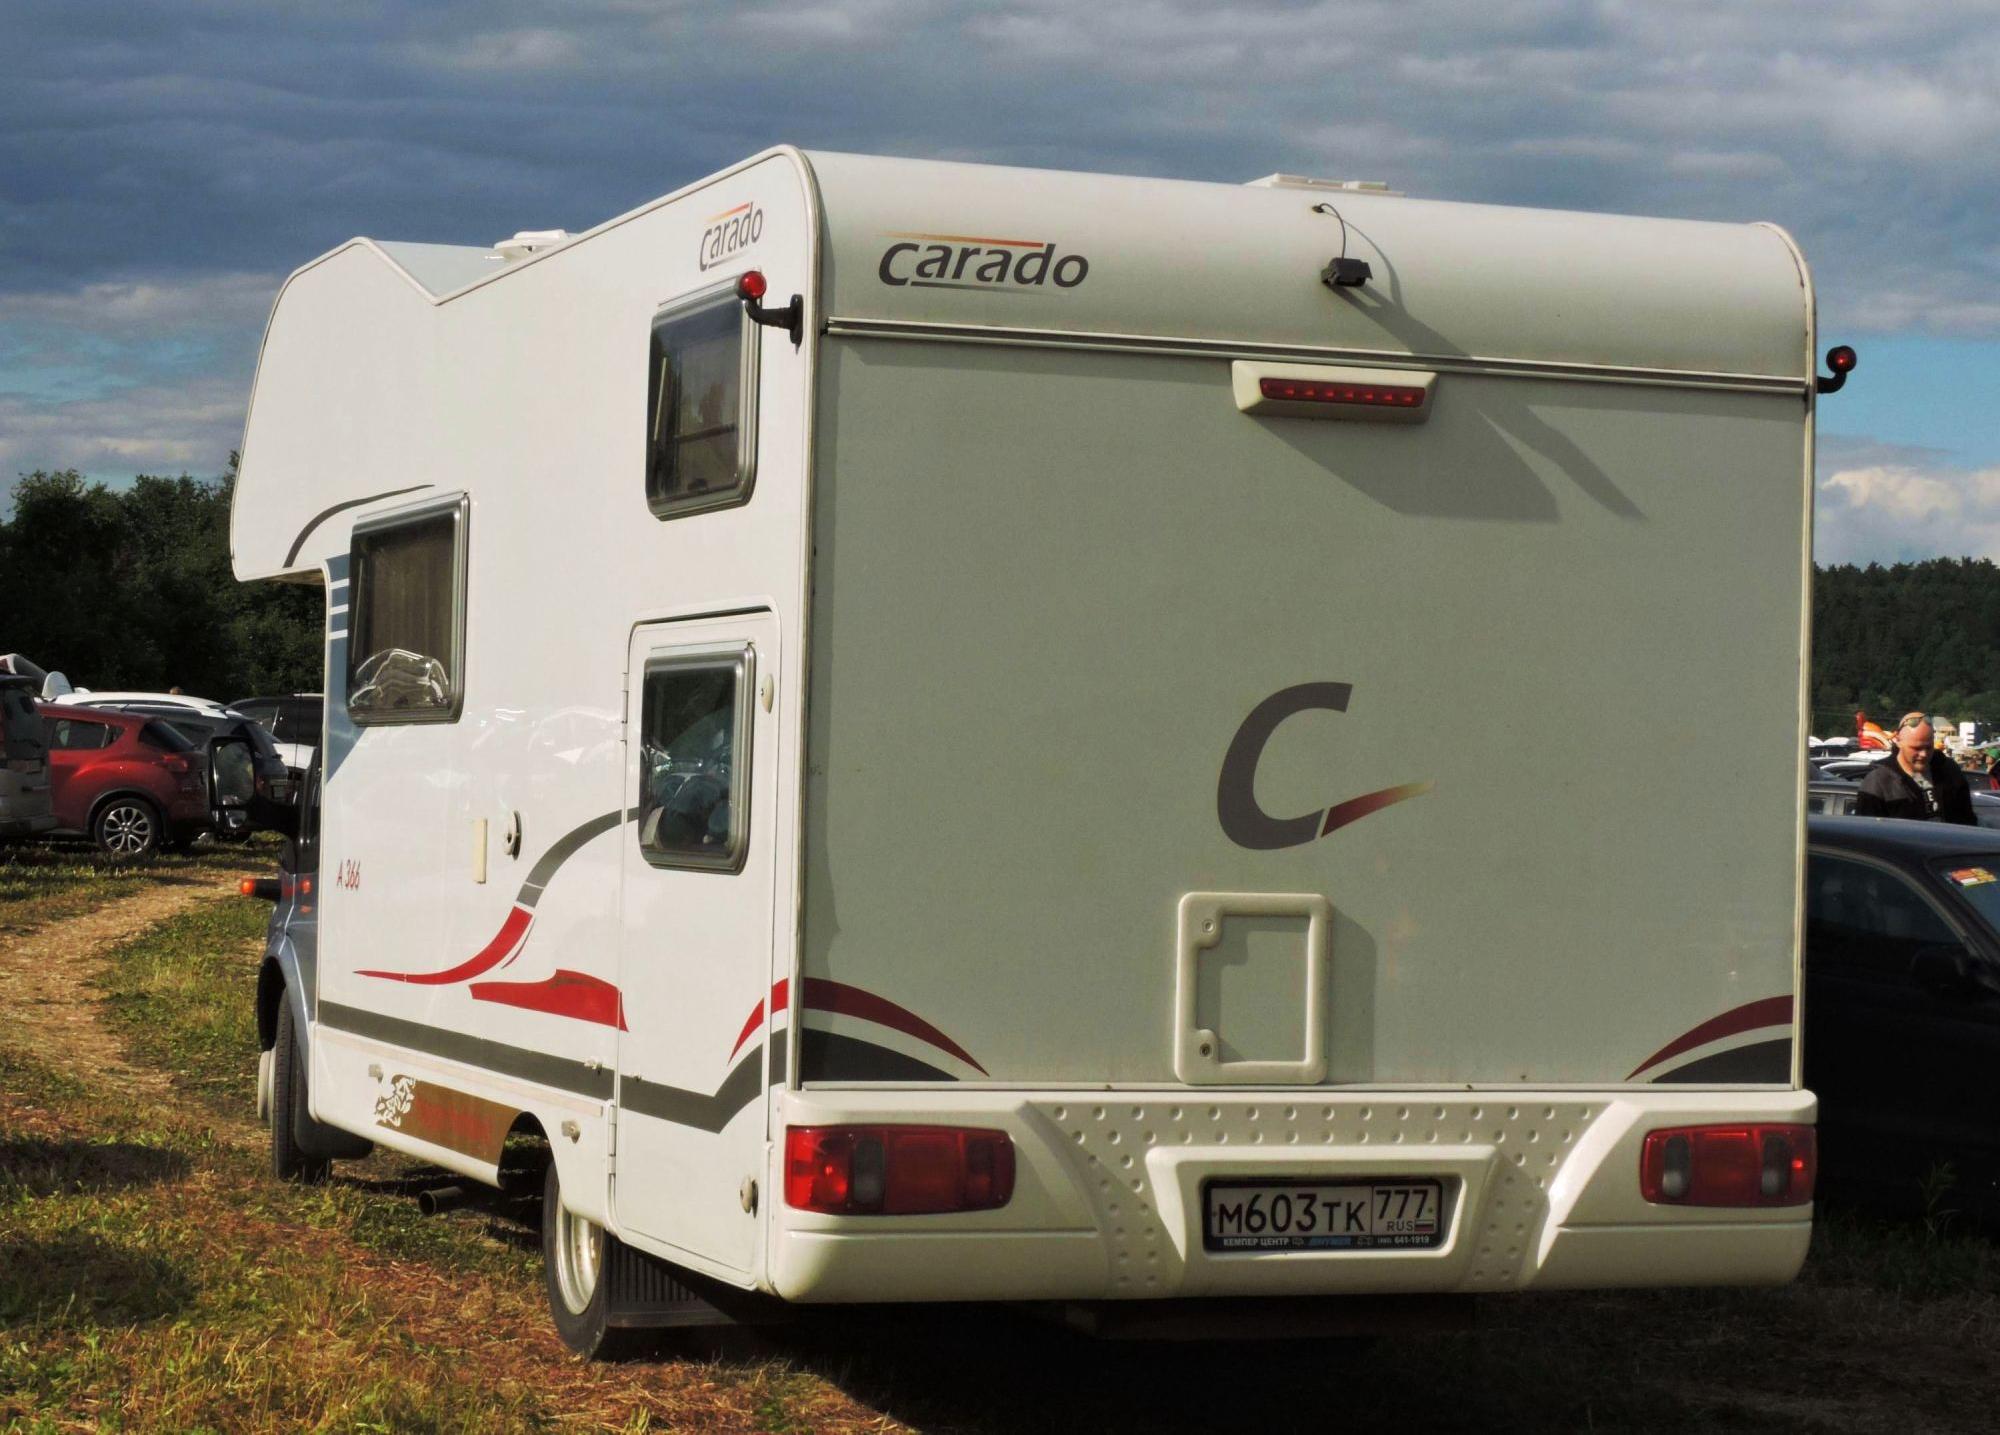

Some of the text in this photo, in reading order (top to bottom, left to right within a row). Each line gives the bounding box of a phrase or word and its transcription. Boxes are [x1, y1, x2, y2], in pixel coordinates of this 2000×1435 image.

[1217, 682, 1353, 850] C
[1376, 1189, 1429, 1219] 777
[1386, 1220, 1414, 1232] RUS
